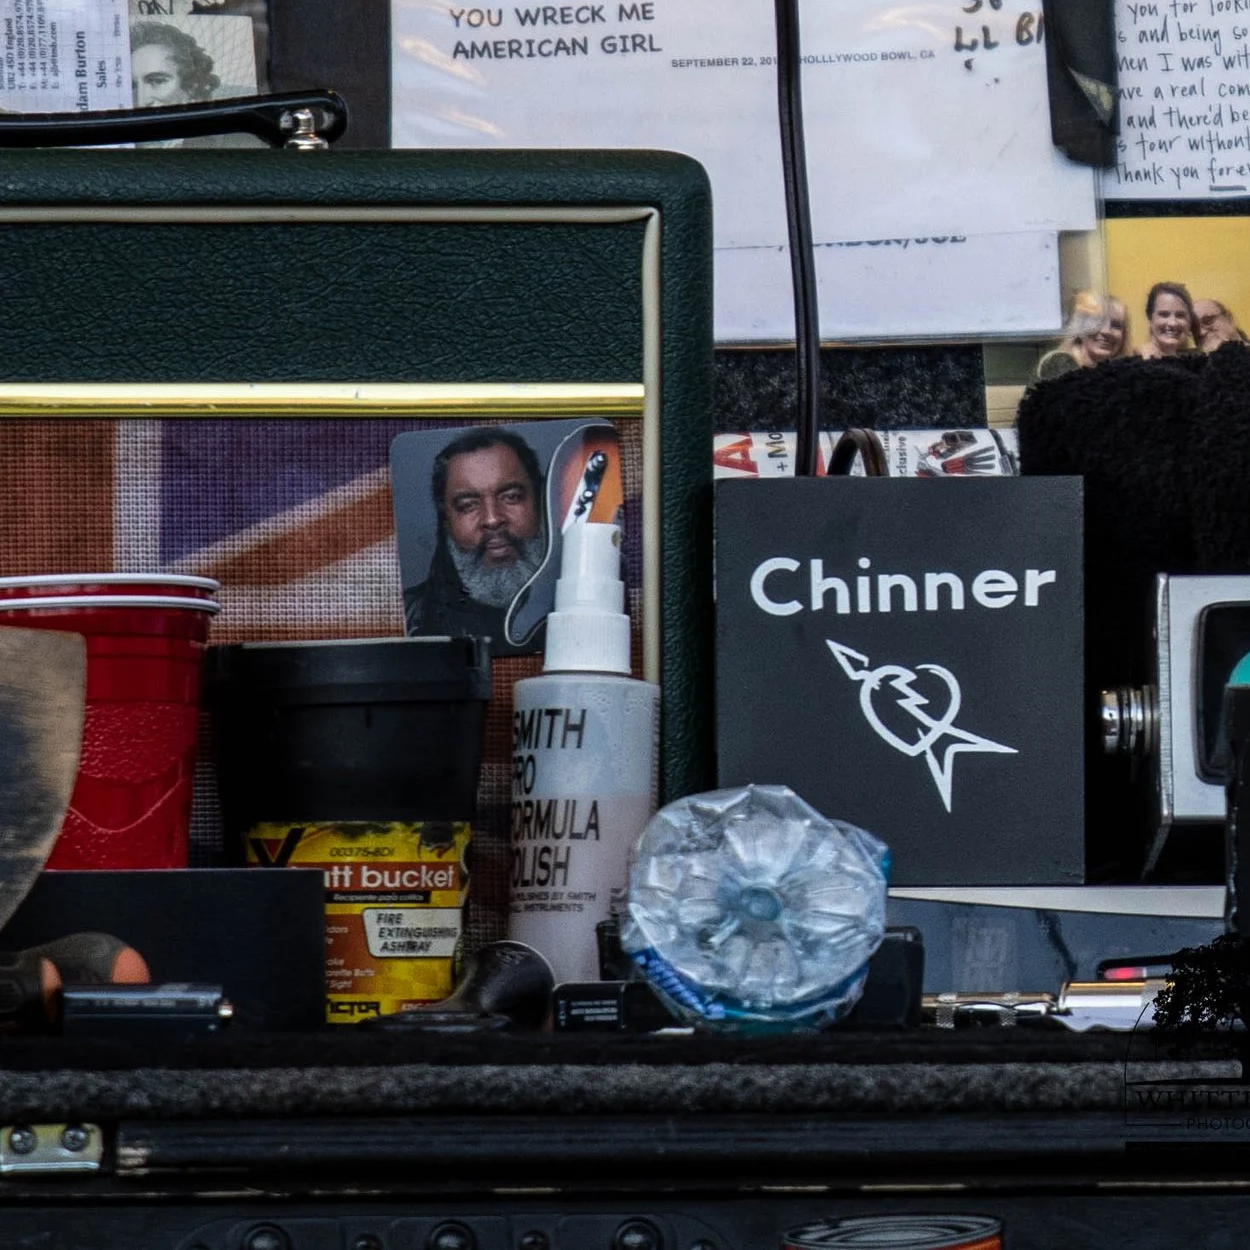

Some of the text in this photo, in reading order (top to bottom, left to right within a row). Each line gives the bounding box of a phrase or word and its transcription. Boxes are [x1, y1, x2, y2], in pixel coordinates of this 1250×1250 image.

[449, 2, 655, 28] YOU WRECK ME
[1130, 4, 1158, 25] you
[74, 31, 87, 78] Burton
[453, 33, 662, 60] AMERICAN GIRL
[671, 57, 739, 68] SEPTEMBER
[760, 56, 778, 66] 201
[881, 51, 915, 62] BOWL,
[920, 50, 935, 60] CA
[96, 59, 107, 88] Sales
[1127, 106, 1157, 129] and
[1231, 102, 1250, 122] be
[1171, 165, 1200, 189] you
[1208, 158, 1231, 183] for
[750, 556, 1056, 616] Chinner
[512, 709, 587, 749] SMITH
[361, 865, 454, 888] bucket
[376, 913, 403, 925] FIRE
[378, 927, 458, 939] EXTINGUISHING
[380, 941, 432, 953] ASHTRAY
